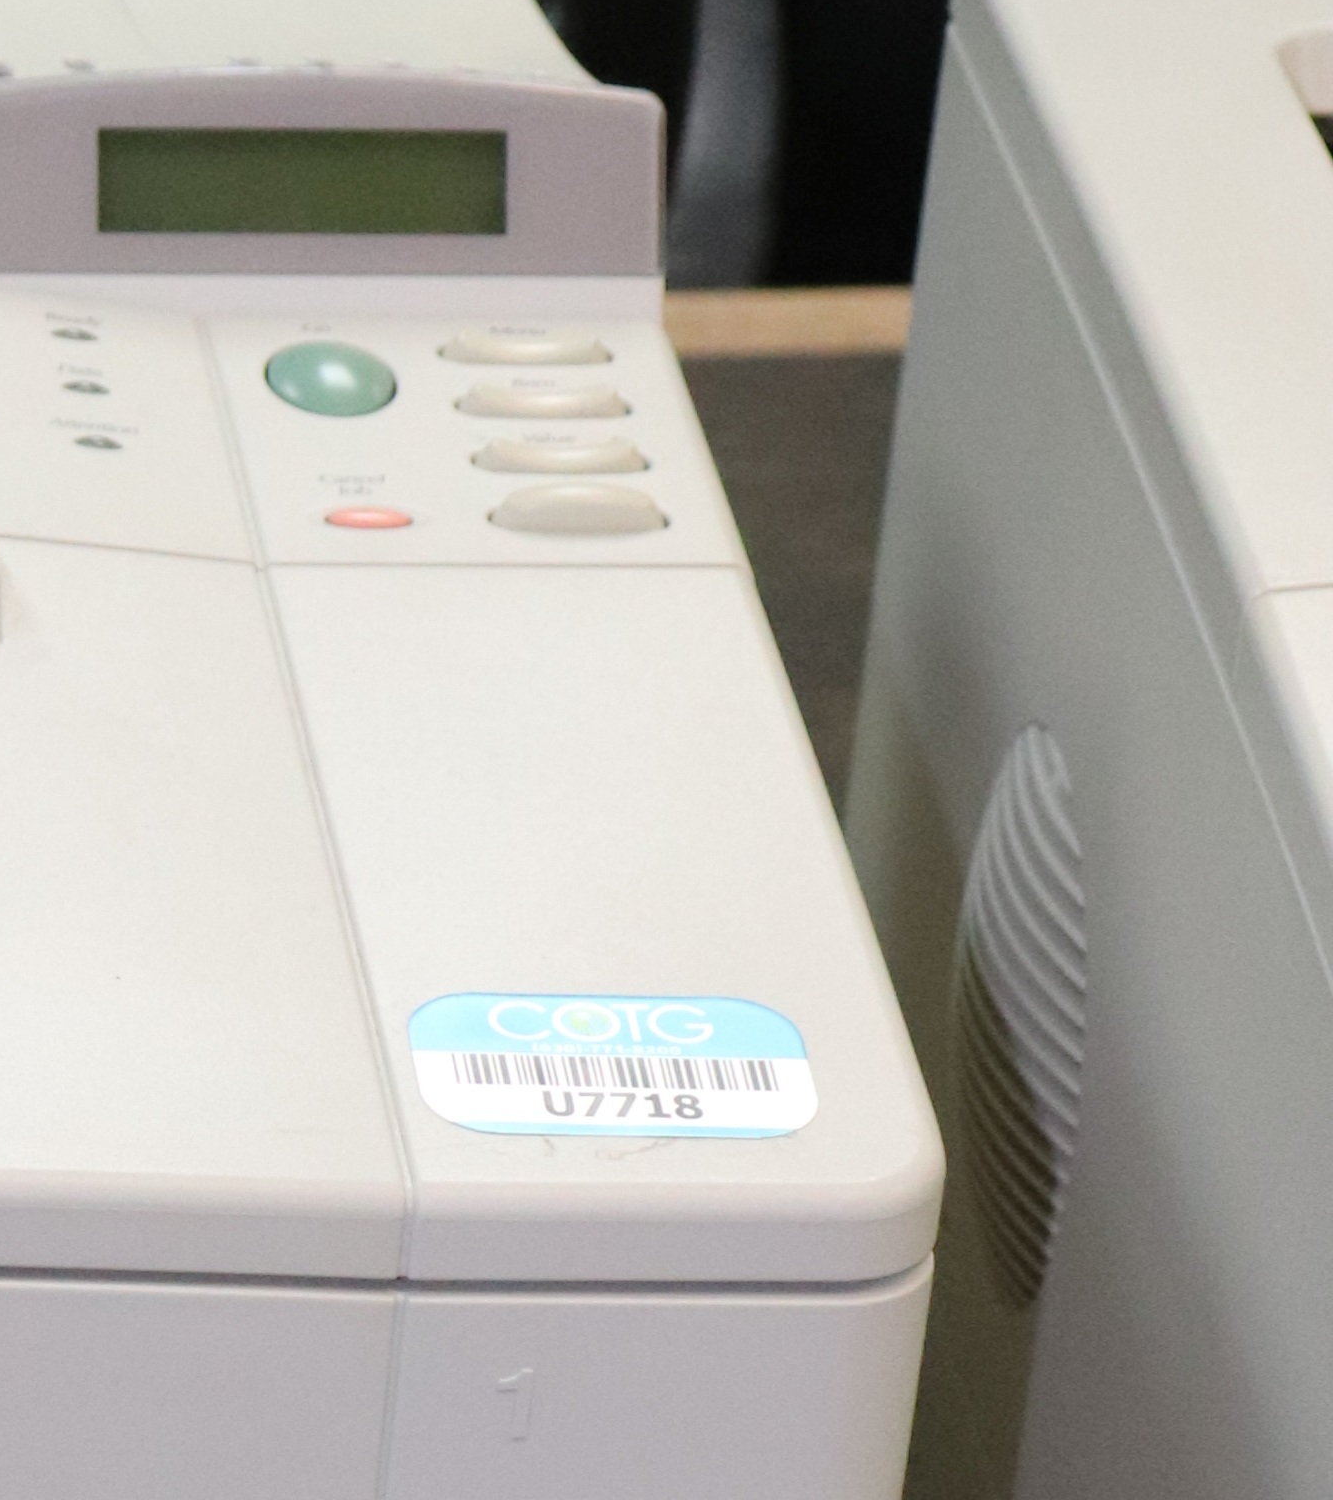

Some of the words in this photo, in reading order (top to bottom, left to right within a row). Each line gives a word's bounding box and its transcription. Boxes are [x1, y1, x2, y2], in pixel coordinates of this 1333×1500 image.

[487, 999, 715, 1045] COTG
[542, 1090, 704, 1121] U7718
[494, 1365, 537, 1442] 1
